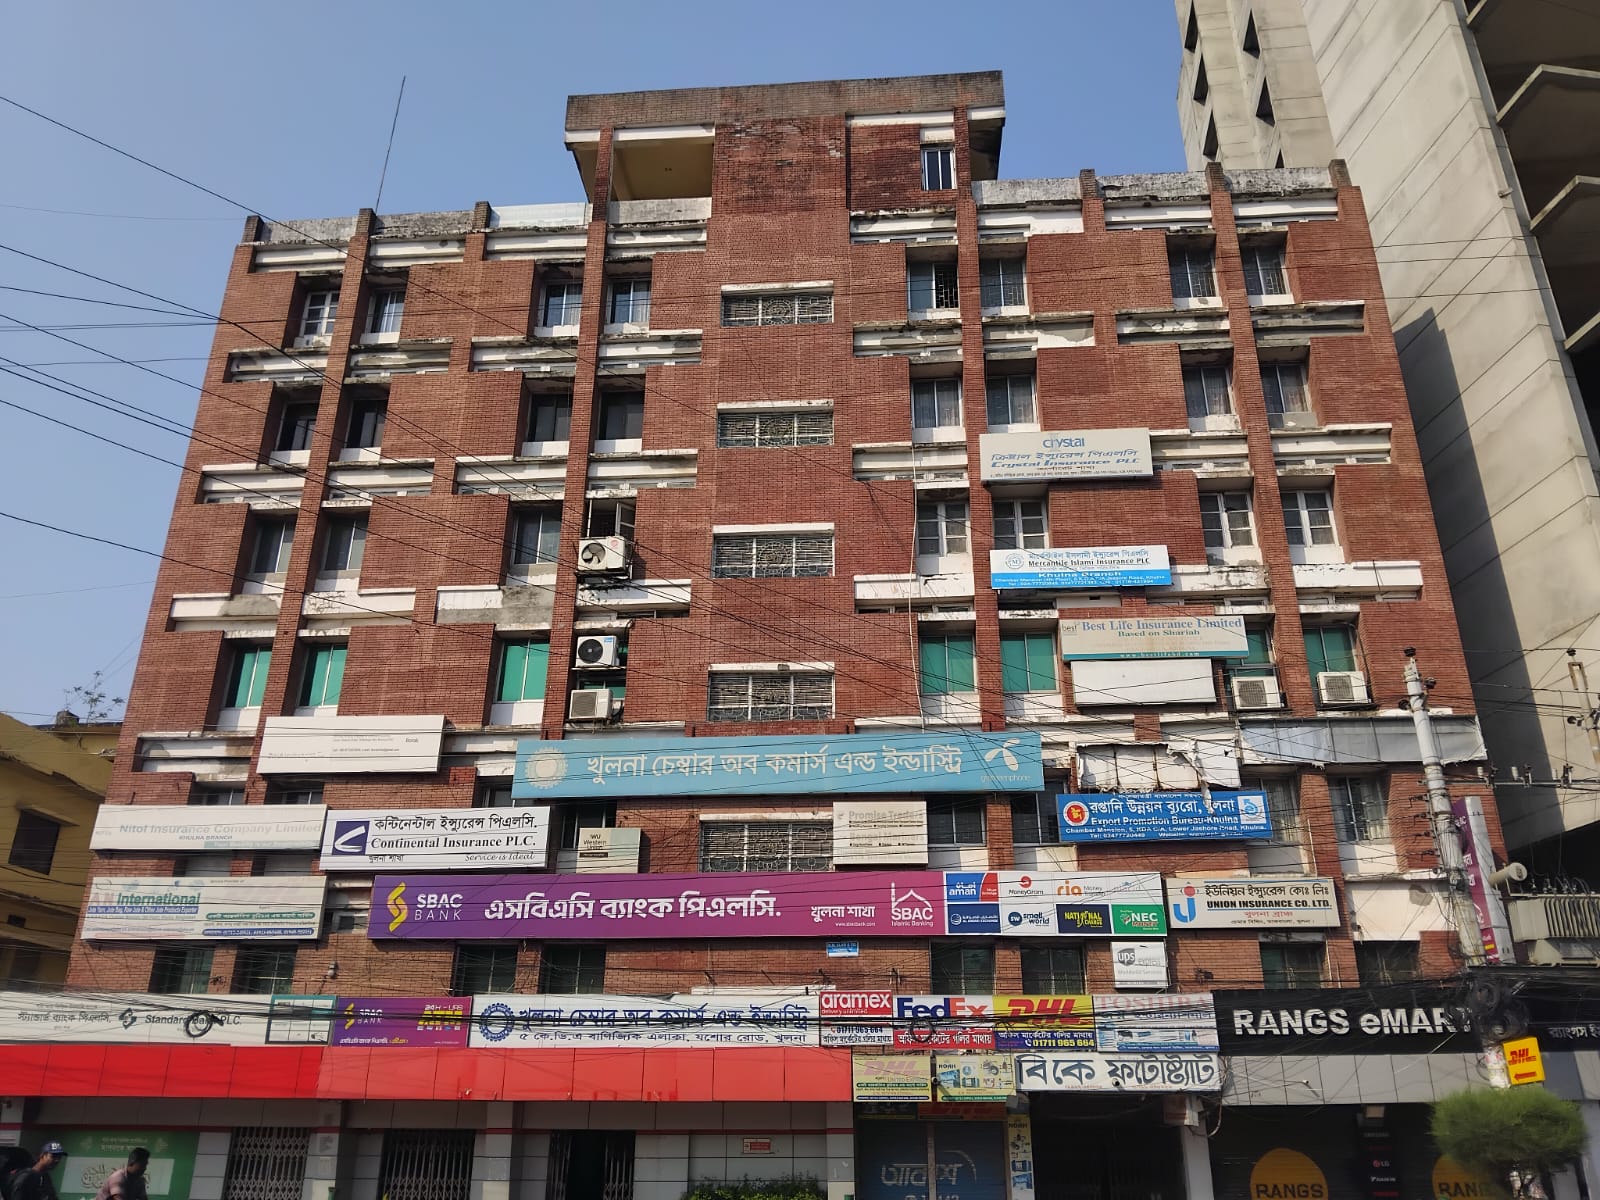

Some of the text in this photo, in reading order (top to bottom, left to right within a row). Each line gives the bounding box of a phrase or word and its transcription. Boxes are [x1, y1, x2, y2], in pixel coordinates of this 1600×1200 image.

[991, 460, 1041, 468] Crystal
[1044, 459, 1111, 467] Insurance
[1028, 557, 1150, 568] Mercantile Islami Insurance PLC
[1082, 617, 1243, 631] Best Life Insurance Limited
[1118, 629, 1146, 638] Based
[1162, 628, 1200, 637] Shariah
[587, 743, 963, 785] খুলনা চেম্বার অব কমার্স এন্ড ইন্ডাস্ট্রি
[1088, 798, 1123, 818] রপ্তানি
[1126, 798, 1163, 818] উন্নয়ন
[374, 815, 436, 831] কন্টিনেন্টাল
[488, 812, 538, 831] পিএলসি.
[1090, 814, 1239, 828] Export Promotion Bureau-Khulna
[119, 823, 148, 834] Nitol
[150, 824, 211, 834] Insurance
[213, 824, 271, 836] Company
[274, 823, 320, 833] Limited
[370, 834, 537, 852] Continental Insurance PLC.
[949, 887, 977, 897] aman
[1008, 888, 1044, 897] MoneyGram
[1056, 879, 1083, 897] ria
[1204, 883, 1247, 899] ইউনিয়ন
[116, 893, 201, 906] International
[416, 893, 463, 910] SBAC
[484, 889, 783, 921] এসবিএসি ব্যাংক পিএলসি.
[1206, 897, 1333, 910] UNION INSURANCE CO. LTD.
[414, 909, 462, 922] BANK
[810, 903, 876, 923] খুলনা শাখা
[890, 908, 934, 922] SBAC
[1023, 911, 1043, 920] small
[1131, 911, 1159, 922] NEC
[890, 920, 935, 929] Islamic Banking
[1028, 917, 1050, 925] world
[1118, 951, 1136, 965] ups
[821, 991, 892, 1010] aramex
[821, 1008, 869, 1017] delivery unlimited
[896, 997, 989, 1019] FedEx
[1007, 998, 1083, 1025] DHL
[1232, 1007, 1473, 1036] RANGS eMAR
[695, 1033, 732, 1043] যশোর
[773, 1033, 807, 1044] খুলনা
[1032, 1039, 1056, 1048] 01711
[1057, 1038, 1076, 1047] 965
[864, 1060, 918, 1076] DHL
[1255, 1183, 1325, 1199] RANGS
